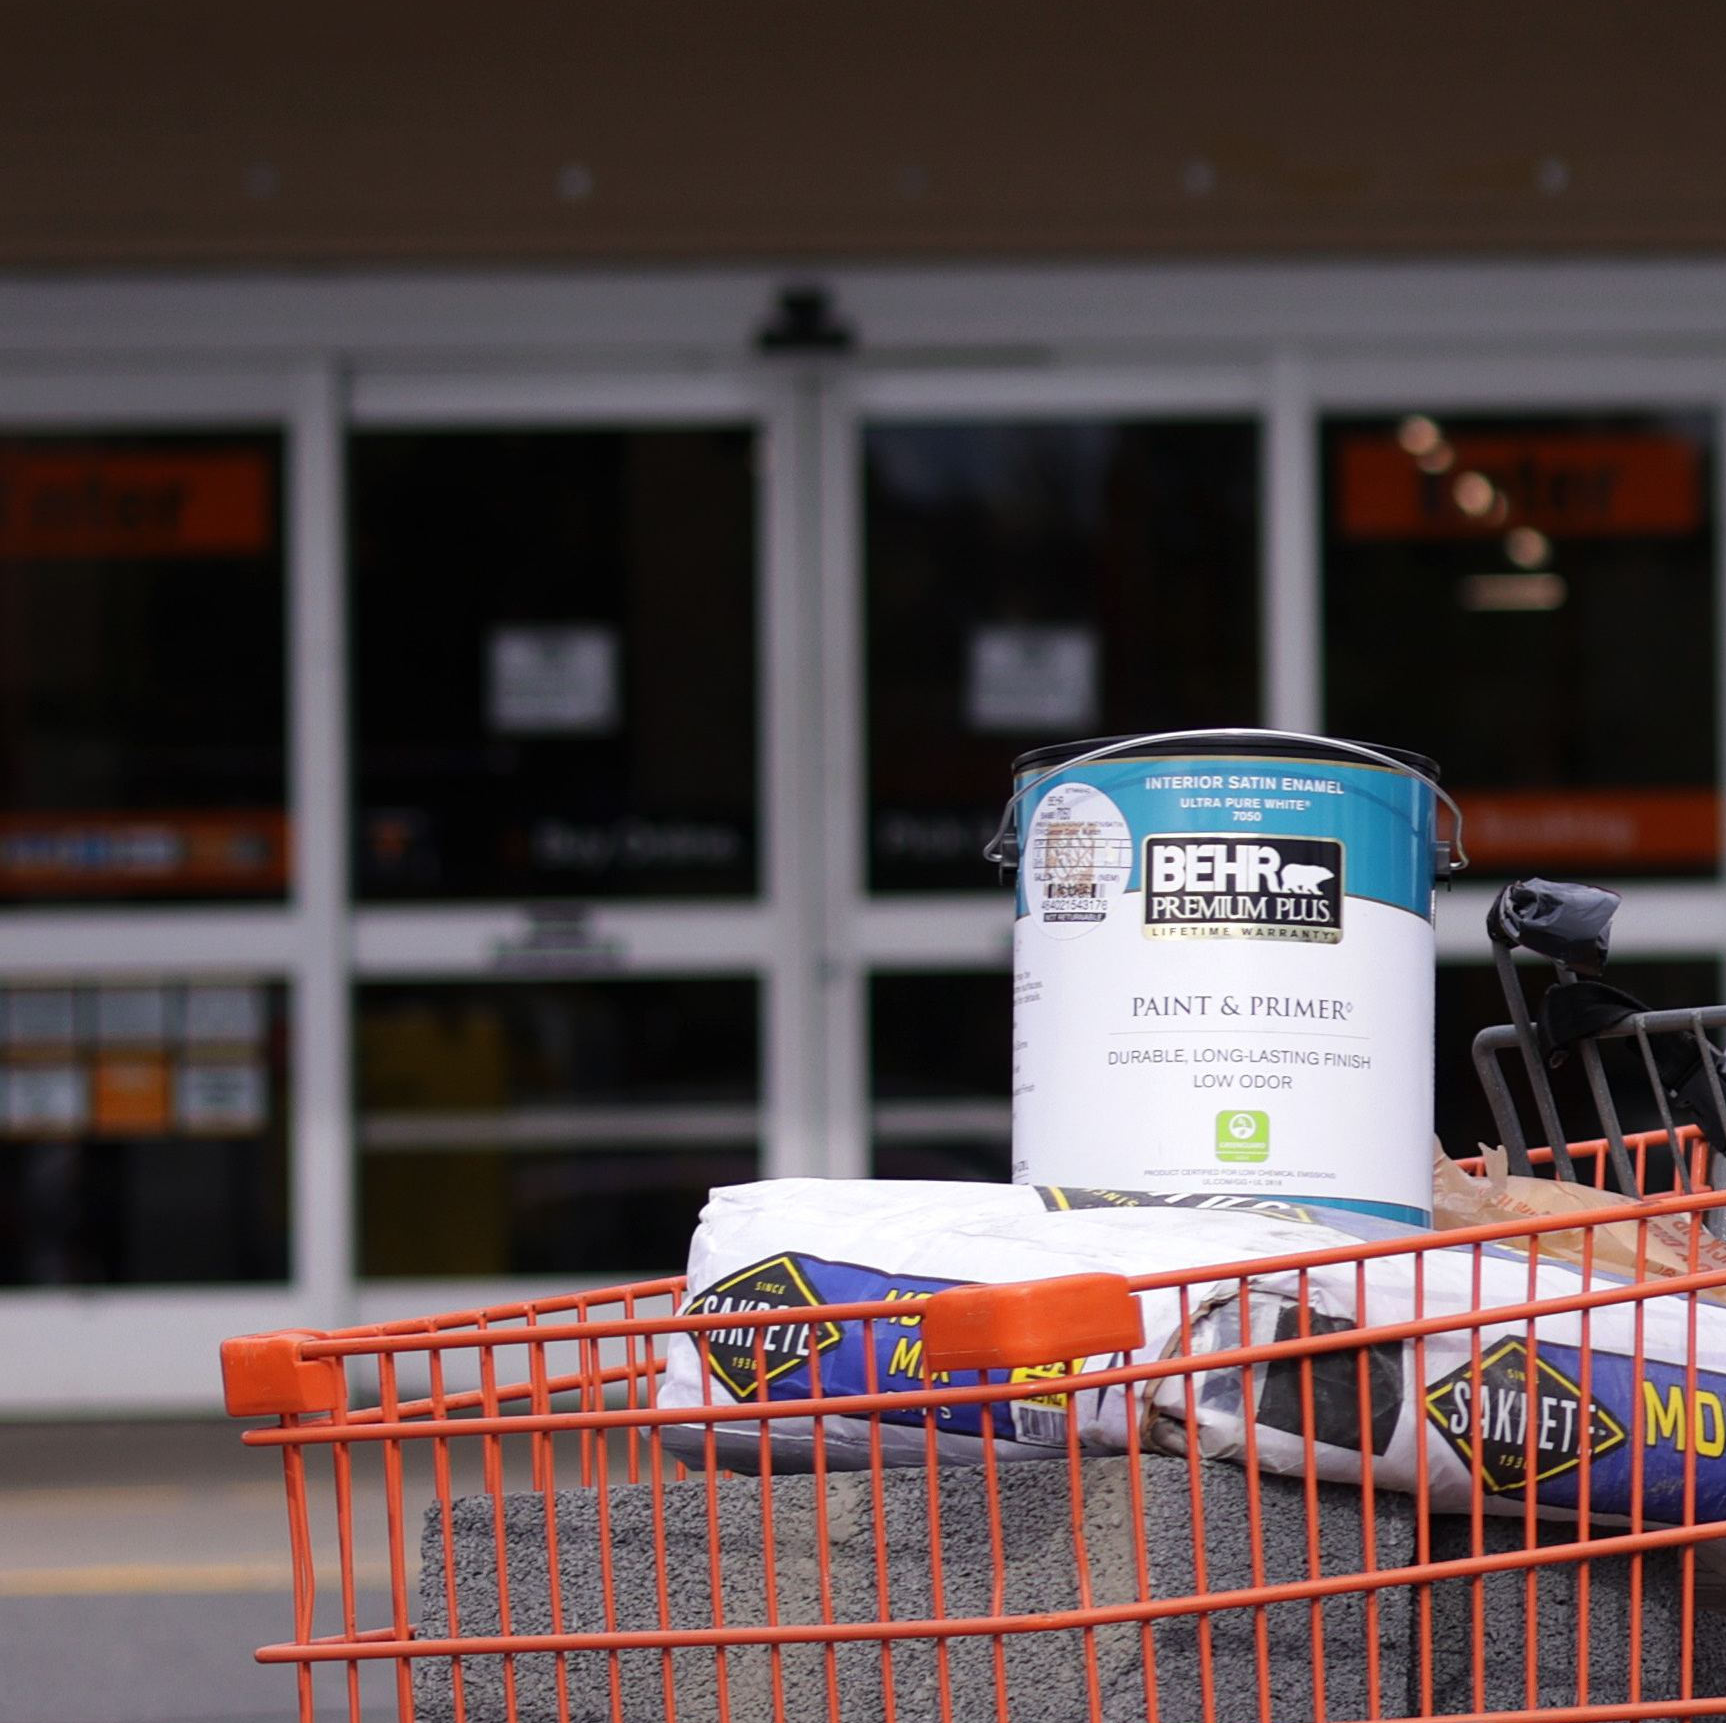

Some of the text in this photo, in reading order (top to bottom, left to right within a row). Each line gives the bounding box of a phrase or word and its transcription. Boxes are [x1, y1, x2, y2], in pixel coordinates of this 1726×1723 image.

[1145, 776, 1345, 795] INTERIOR SATIN ENAMEL
[1180, 797, 1222, 808] ULTRA
[1225, 797, 1261, 809] PURE
[1232, 811, 1262, 822] 7050
[1152, 844, 1281, 894] BEHR
[1152, 895, 1330, 922] PREMIUM PLUS
[1152, 927, 1231, 937] LIFETIME
[1132, 995, 1212, 1018] PAINT
[1220, 995, 1241, 1016] &
[1108, 1048, 1371, 1069] DURABLE, LONG-LASTING FINISH
[1193, 1074, 1293, 1089] LOW ODOR
[1144, 1169, 1179, 1177] PRODUCT
[1257, 1169, 1295, 1177] CHEMICAL
[1297, 1171, 1336, 1179] EMISSIONS
[755, 1281, 786, 1295] SINCE
